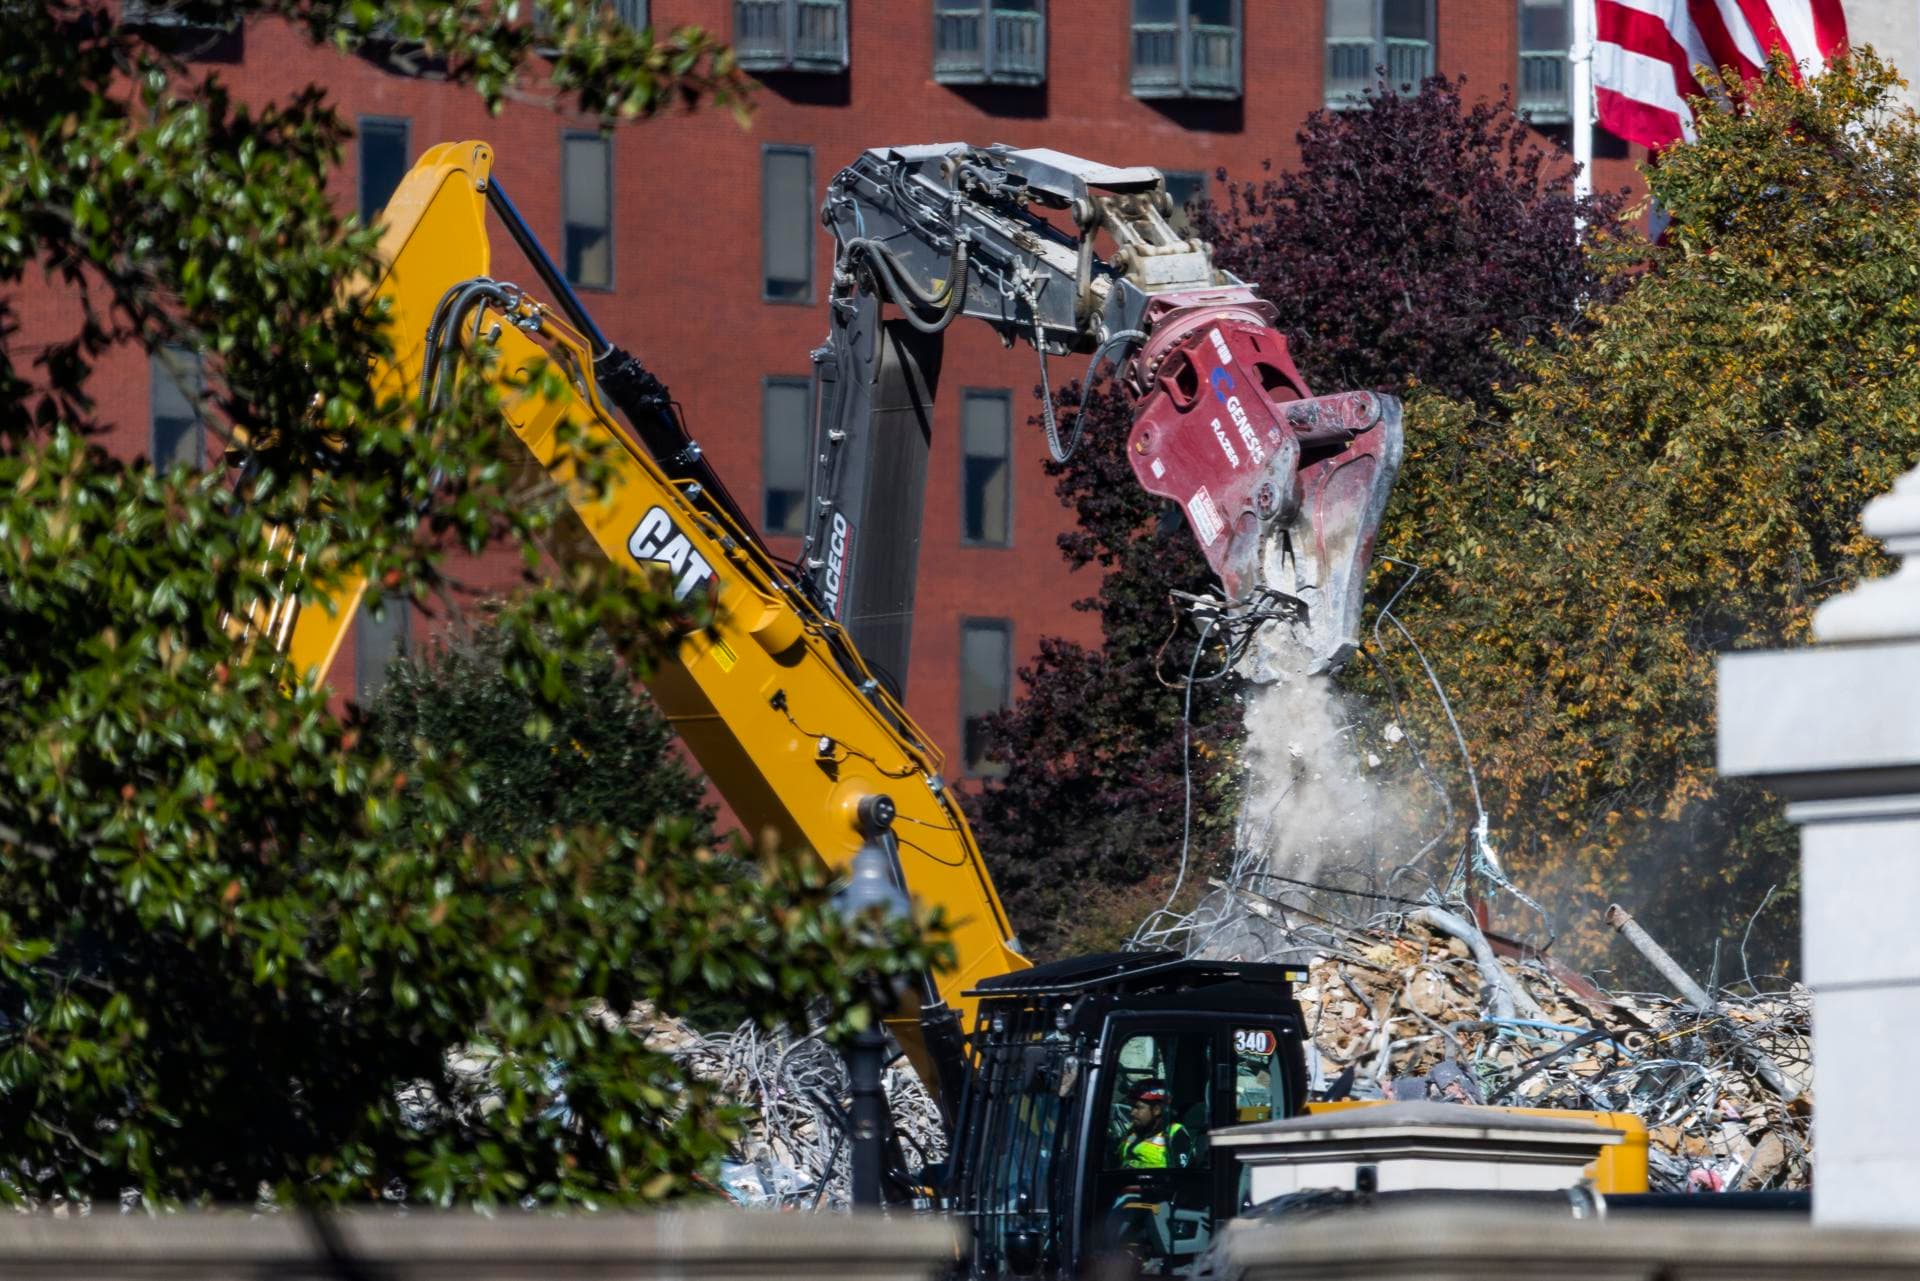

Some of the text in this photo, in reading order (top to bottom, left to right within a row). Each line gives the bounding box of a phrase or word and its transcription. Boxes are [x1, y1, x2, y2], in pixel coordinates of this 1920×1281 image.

[1210, 418, 1239, 469] RAZER
[1227, 396, 1265, 465] GENESIS
[628, 506, 713, 603] CAT
[823, 512, 847, 617] ACECO
[1235, 1031, 1267, 1053] 340
